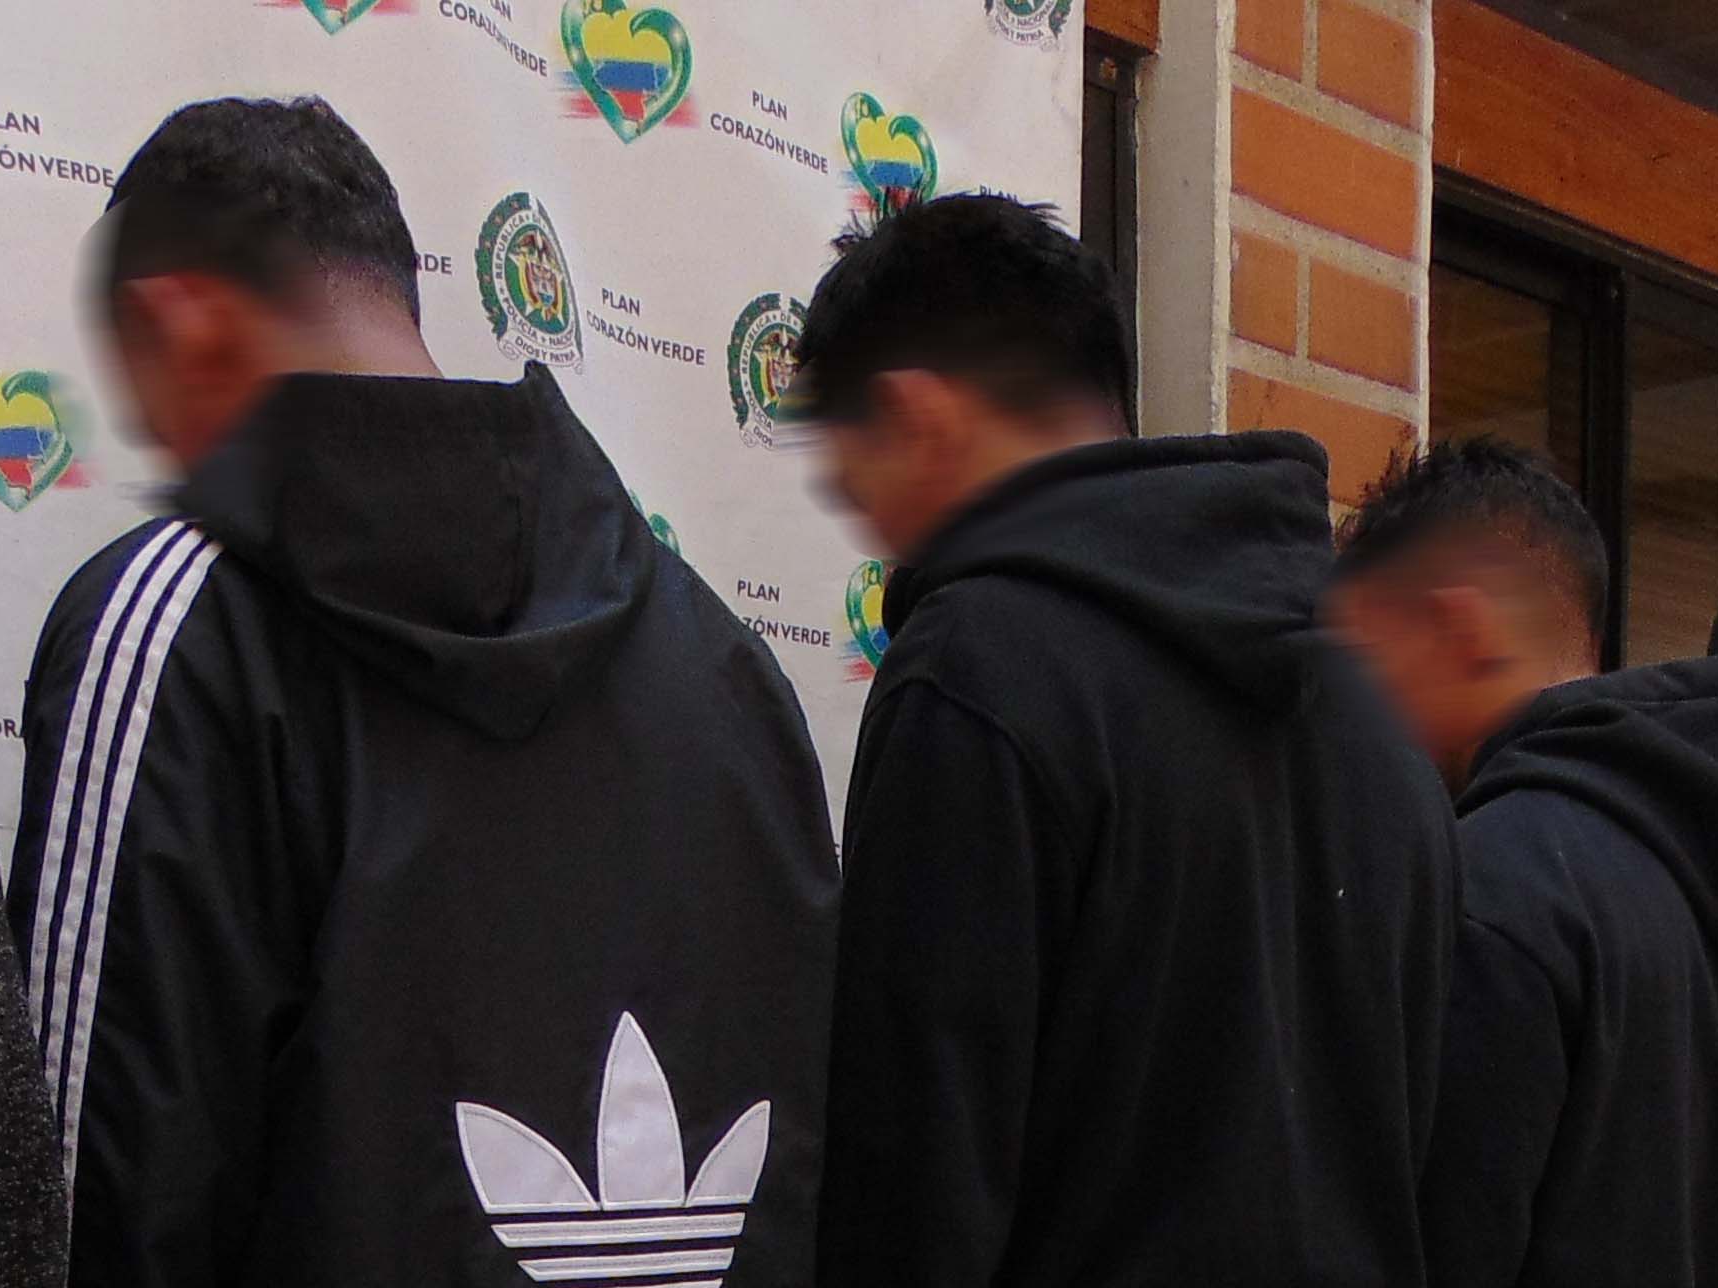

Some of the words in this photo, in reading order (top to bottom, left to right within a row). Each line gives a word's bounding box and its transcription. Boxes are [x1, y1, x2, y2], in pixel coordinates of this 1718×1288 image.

[752, 90, 788, 121] PLAN
[710, 113, 785, 155] CORAZÓN
[787, 145, 829, 174] VERDE
[40, 156, 116, 188] VERDE
[602, 288, 641, 316] PLAN
[586, 309, 649, 351] CORAZÓN
[651, 337, 706, 365] VERDE
[737, 579, 780, 603] PLAN
[778, 622, 831, 647] VERDE
